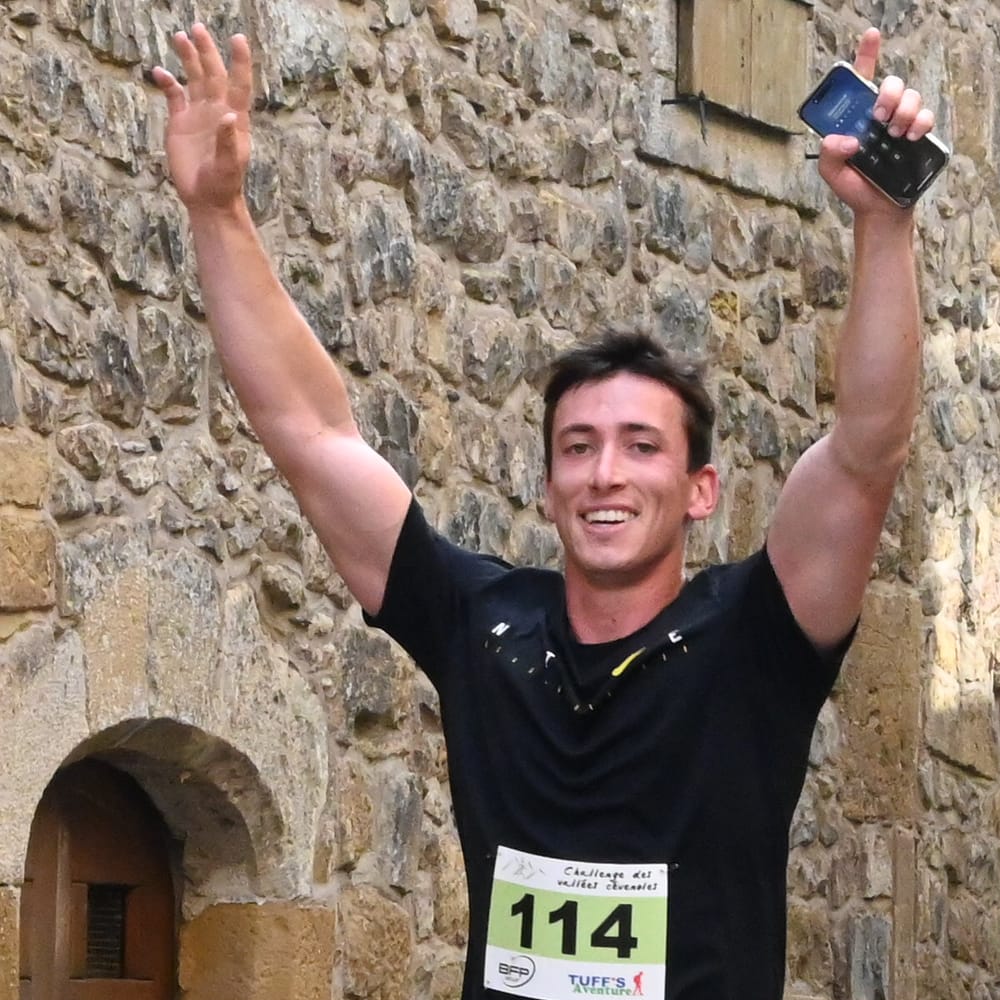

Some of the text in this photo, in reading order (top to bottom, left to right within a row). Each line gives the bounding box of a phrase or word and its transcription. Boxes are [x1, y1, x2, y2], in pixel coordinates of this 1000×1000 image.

[564, 866, 653, 882] Challenge des
[511, 893, 638, 958] 114
[568, 974, 626, 988] TUFF'S
[573, 985, 633, 996] Aventure
